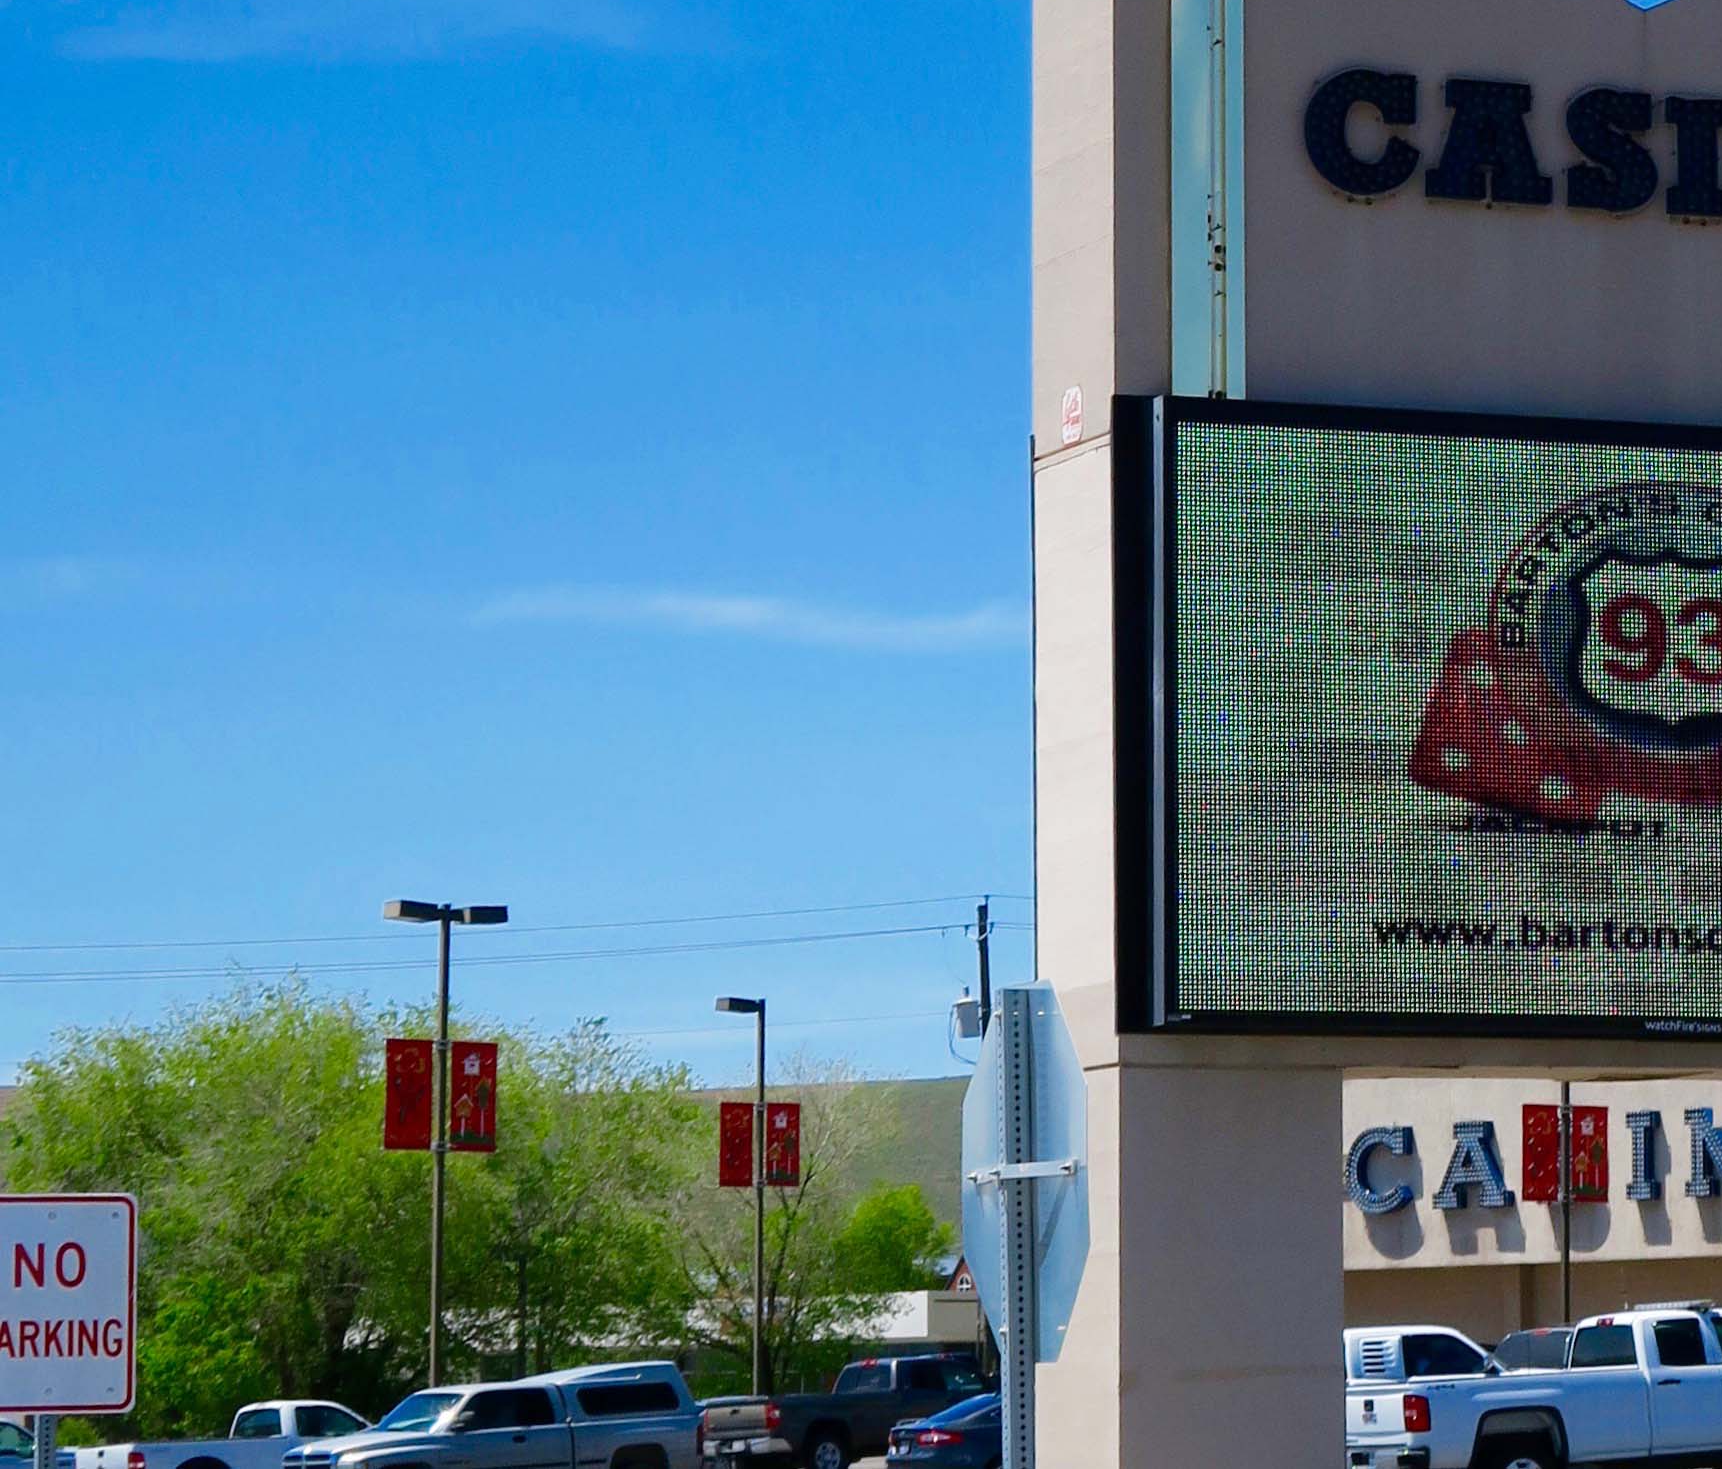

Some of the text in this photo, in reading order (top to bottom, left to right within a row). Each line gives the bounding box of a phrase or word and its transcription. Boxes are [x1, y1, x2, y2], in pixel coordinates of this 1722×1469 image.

[1500, 494, 1681, 649] BARTON'S
[14, 1241, 87, 1289] NO
[0, 1318, 124, 1359] ARKING
